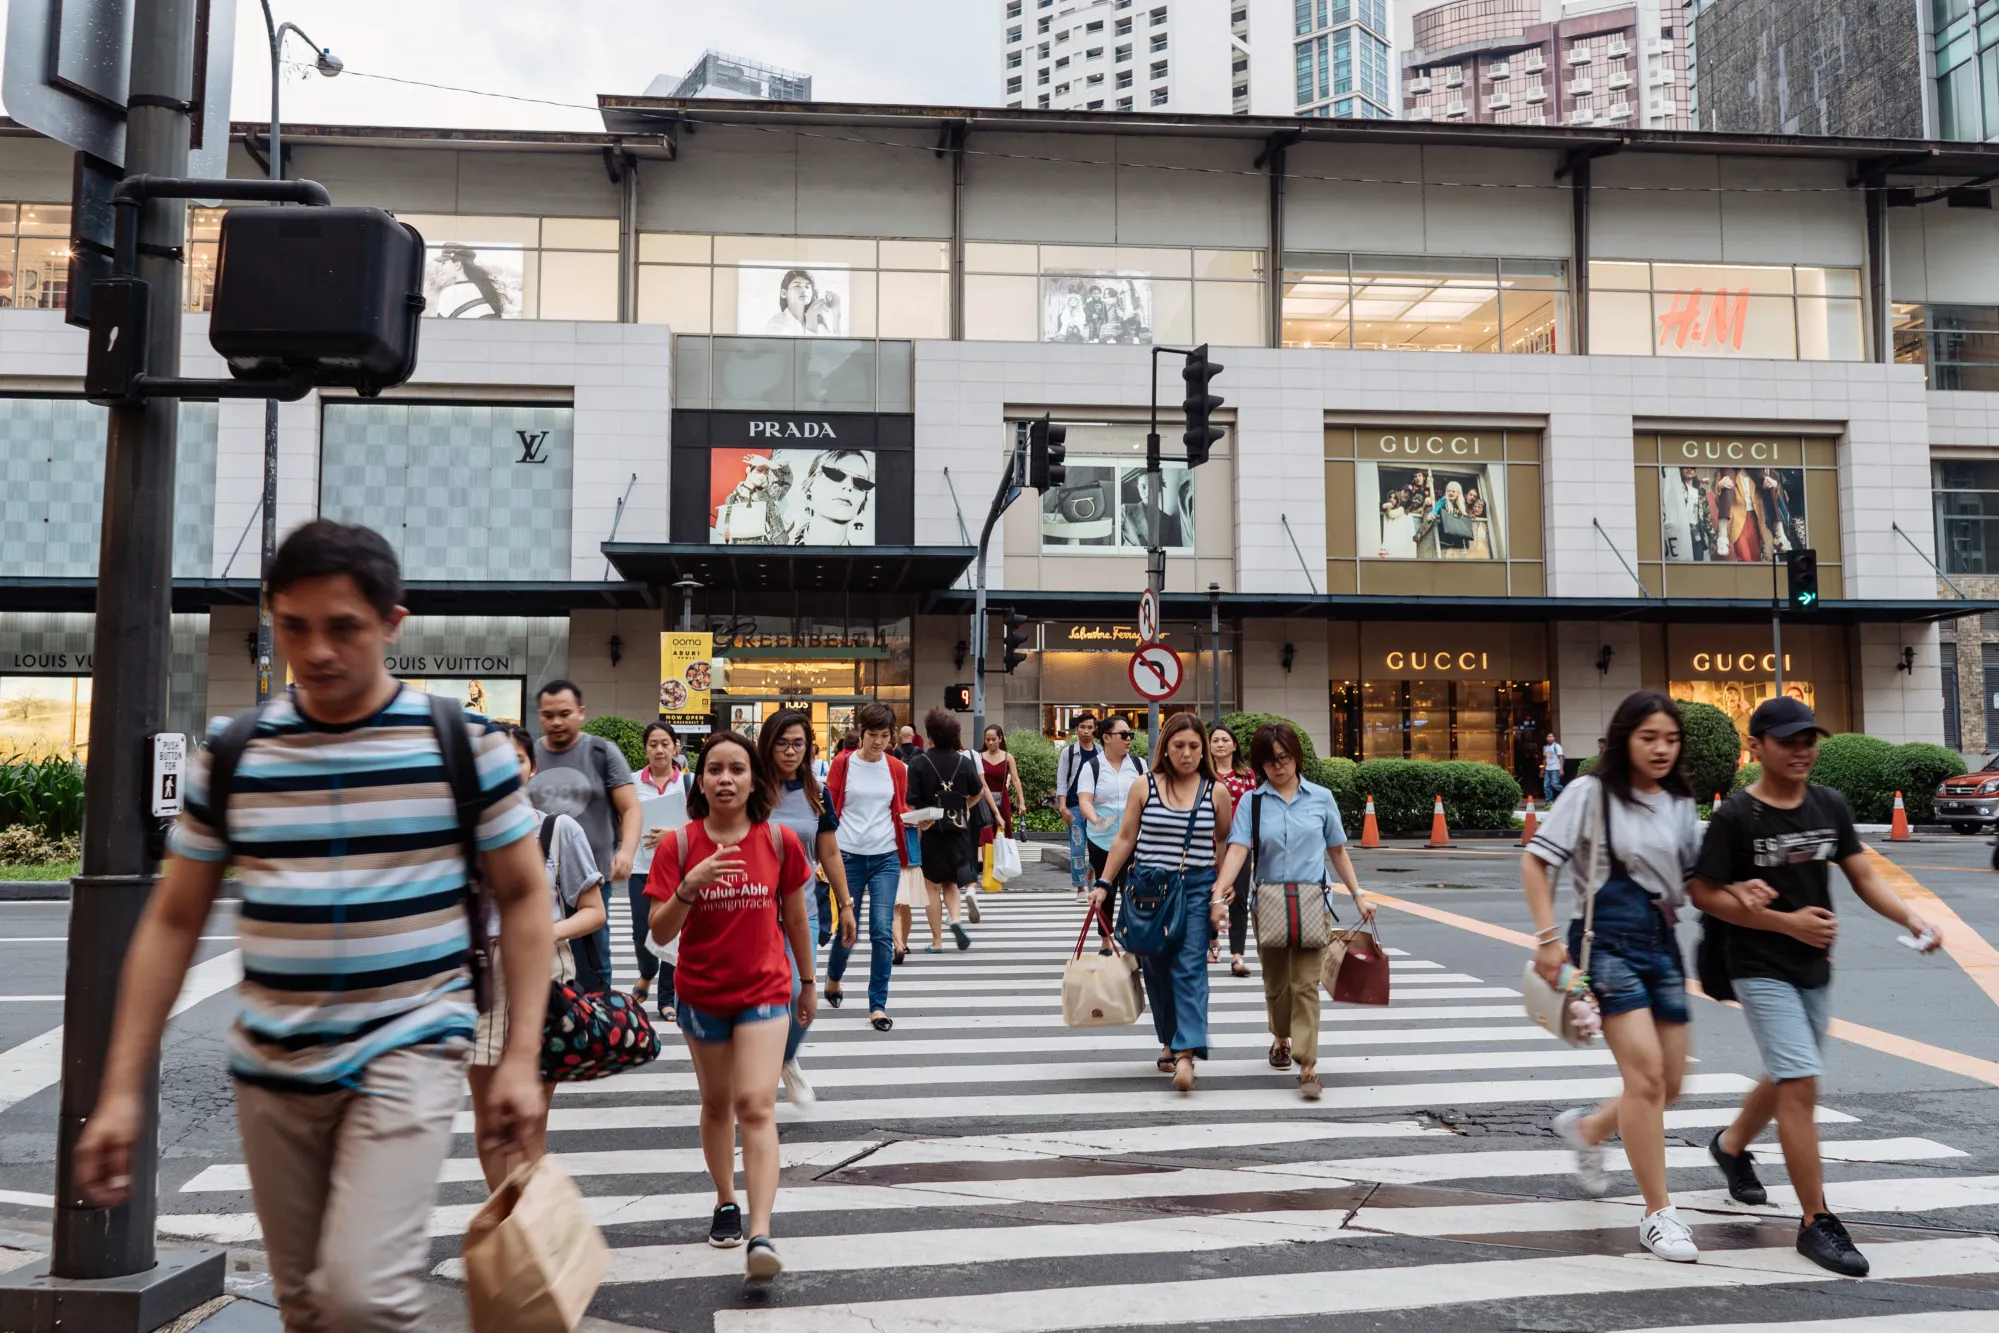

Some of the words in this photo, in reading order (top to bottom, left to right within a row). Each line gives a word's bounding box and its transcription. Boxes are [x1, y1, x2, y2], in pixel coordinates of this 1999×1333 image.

[1657, 287, 1751, 351] H&M
[749, 421, 837, 438] PRADA
[515, 430, 550, 464] LV
[1380, 435, 1480, 455] GUCCI
[1682, 440, 1778, 460] GUCCI
[672, 638, 702, 646] ooma
[712, 622, 867, 658] GREENBELT
[873, 628, 889, 653] 4
[1068, 625, 1112, 641] Salvatore
[1112, 625, 1171, 647] Ferrago
[14, 654, 67, 668] LOUIS
[383, 657, 426, 671] OUIS
[433, 657, 510, 671] VUITTON
[1386, 651, 1488, 670] GUCCI
[1692, 653, 1792, 672] GUCCI
[961, 689, 969, 705] 9
[163, 741, 180, 750] PUSH
[159, 751, 182, 761] BUTTON
[164, 761, 177, 771] FOR
[741, 871, 749, 883] a
[699, 882, 769, 901] Value-Able
